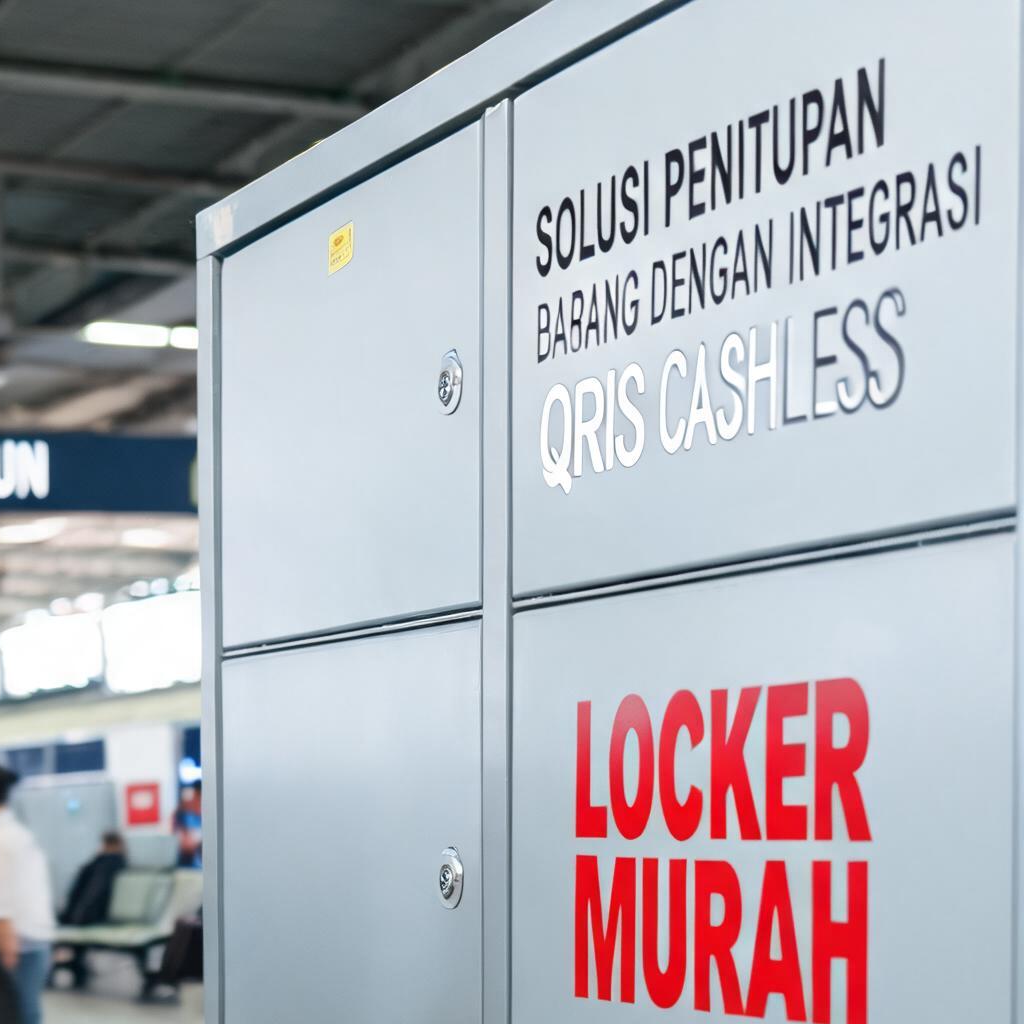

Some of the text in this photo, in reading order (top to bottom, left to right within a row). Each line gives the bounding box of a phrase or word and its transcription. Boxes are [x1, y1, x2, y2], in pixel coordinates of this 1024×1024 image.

[535, 57, 886, 278] SOLUSI PENITUPAN
[650, 218, 774, 326] DENGAN
[789, 145, 982, 285] INTEGRASI
[539, 286, 907, 496] QRIS CASHLESS
[575, 677, 873, 842] LOCKER
